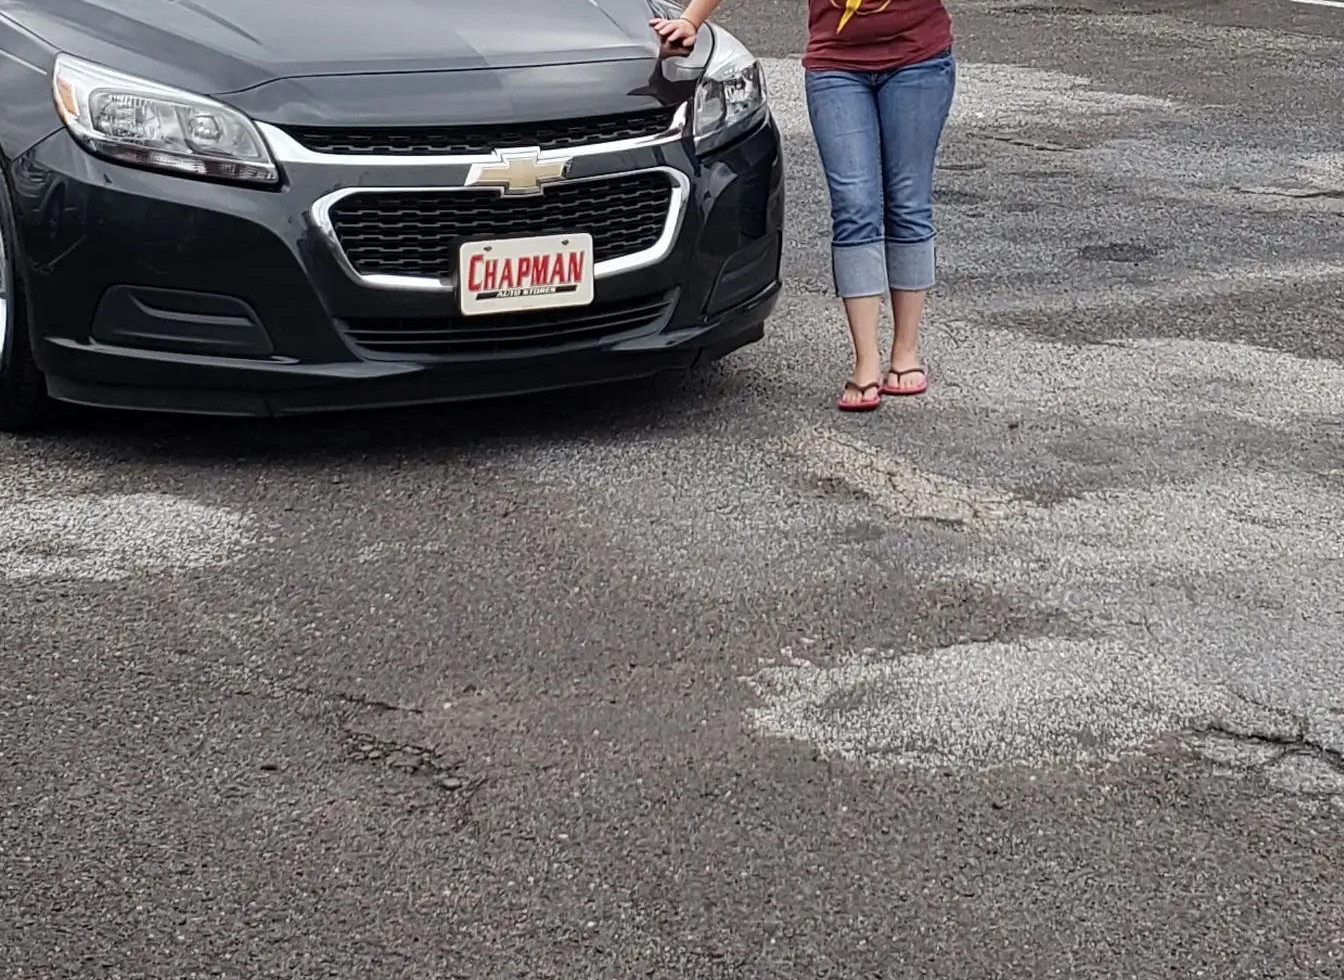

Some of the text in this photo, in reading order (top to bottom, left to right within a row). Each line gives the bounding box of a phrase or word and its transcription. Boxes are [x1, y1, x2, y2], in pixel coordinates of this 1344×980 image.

[467, 251, 585, 292] CHAPMAN
[495, 287, 556, 298] AUTO STORES
